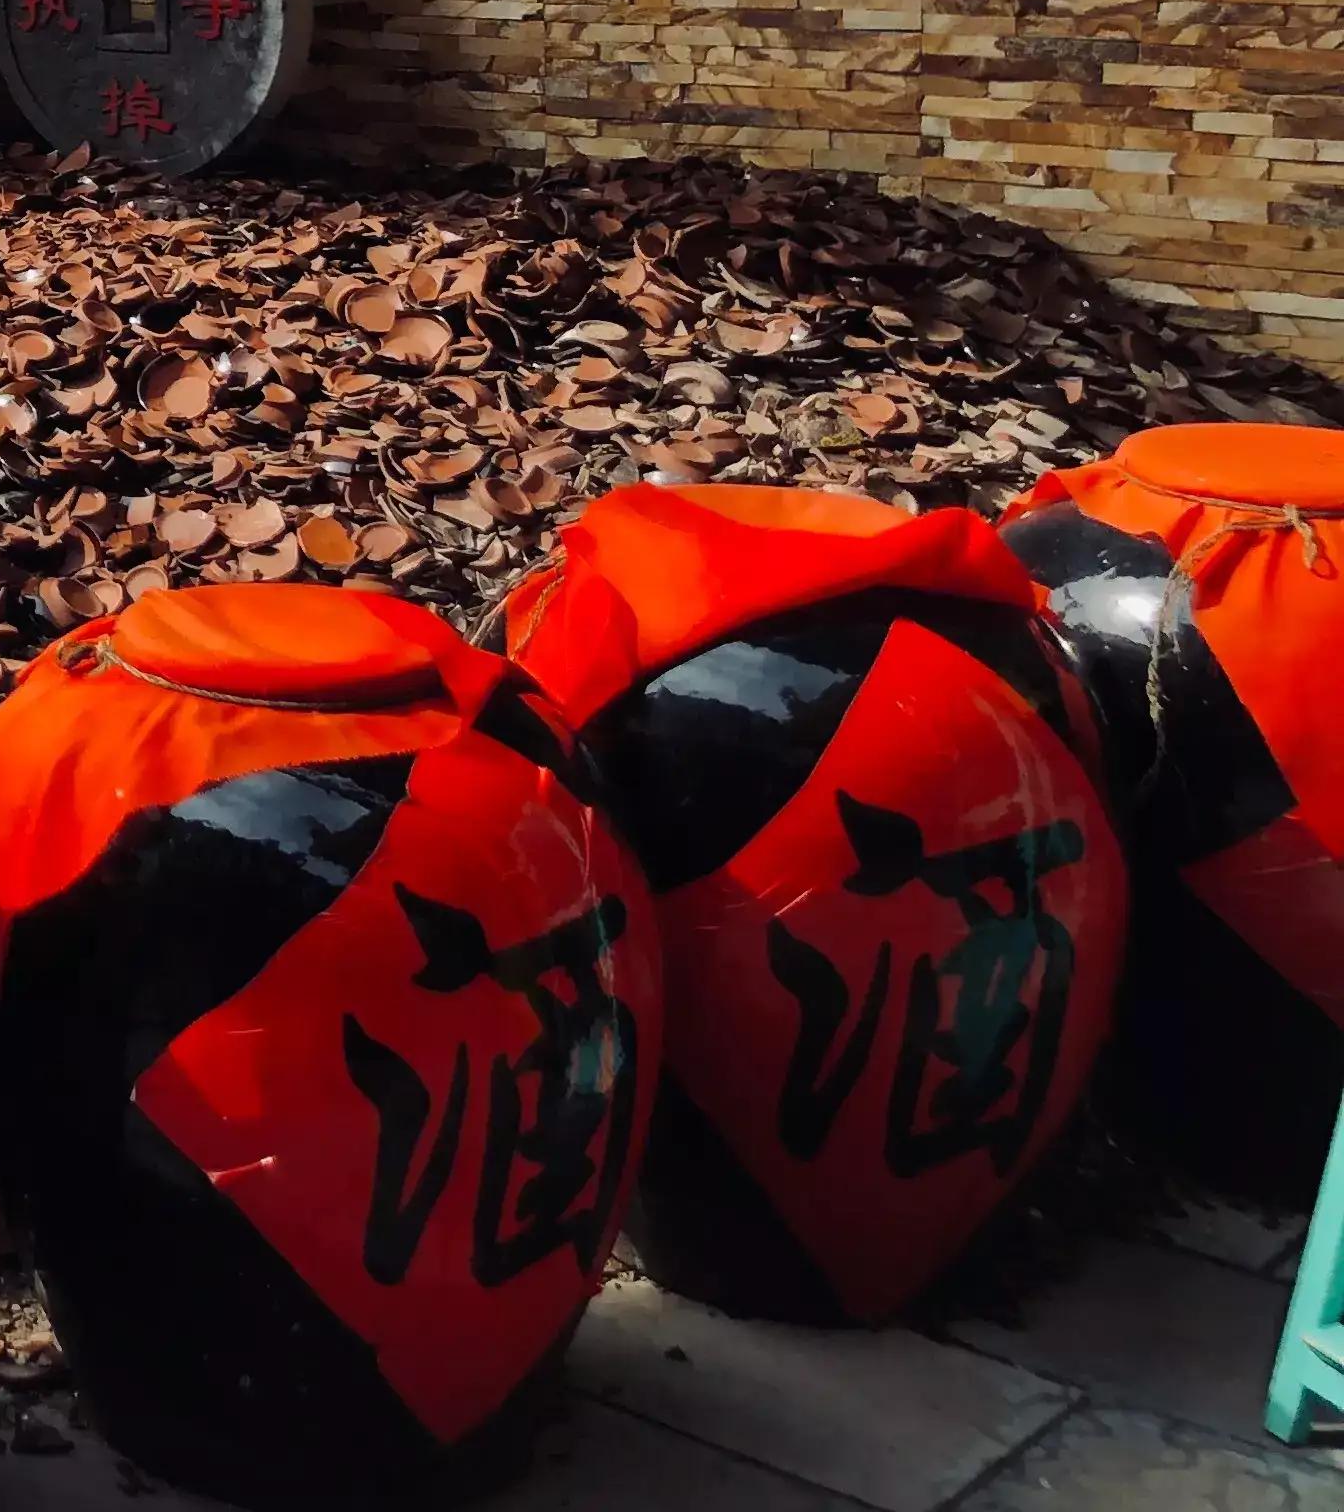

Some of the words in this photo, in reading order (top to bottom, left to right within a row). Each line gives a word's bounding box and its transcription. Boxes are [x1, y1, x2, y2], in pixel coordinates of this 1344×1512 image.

[100, 75, 177, 143] 掉
[342, 880, 638, 1287] 酒
[766, 788, 1084, 1178] 酒
